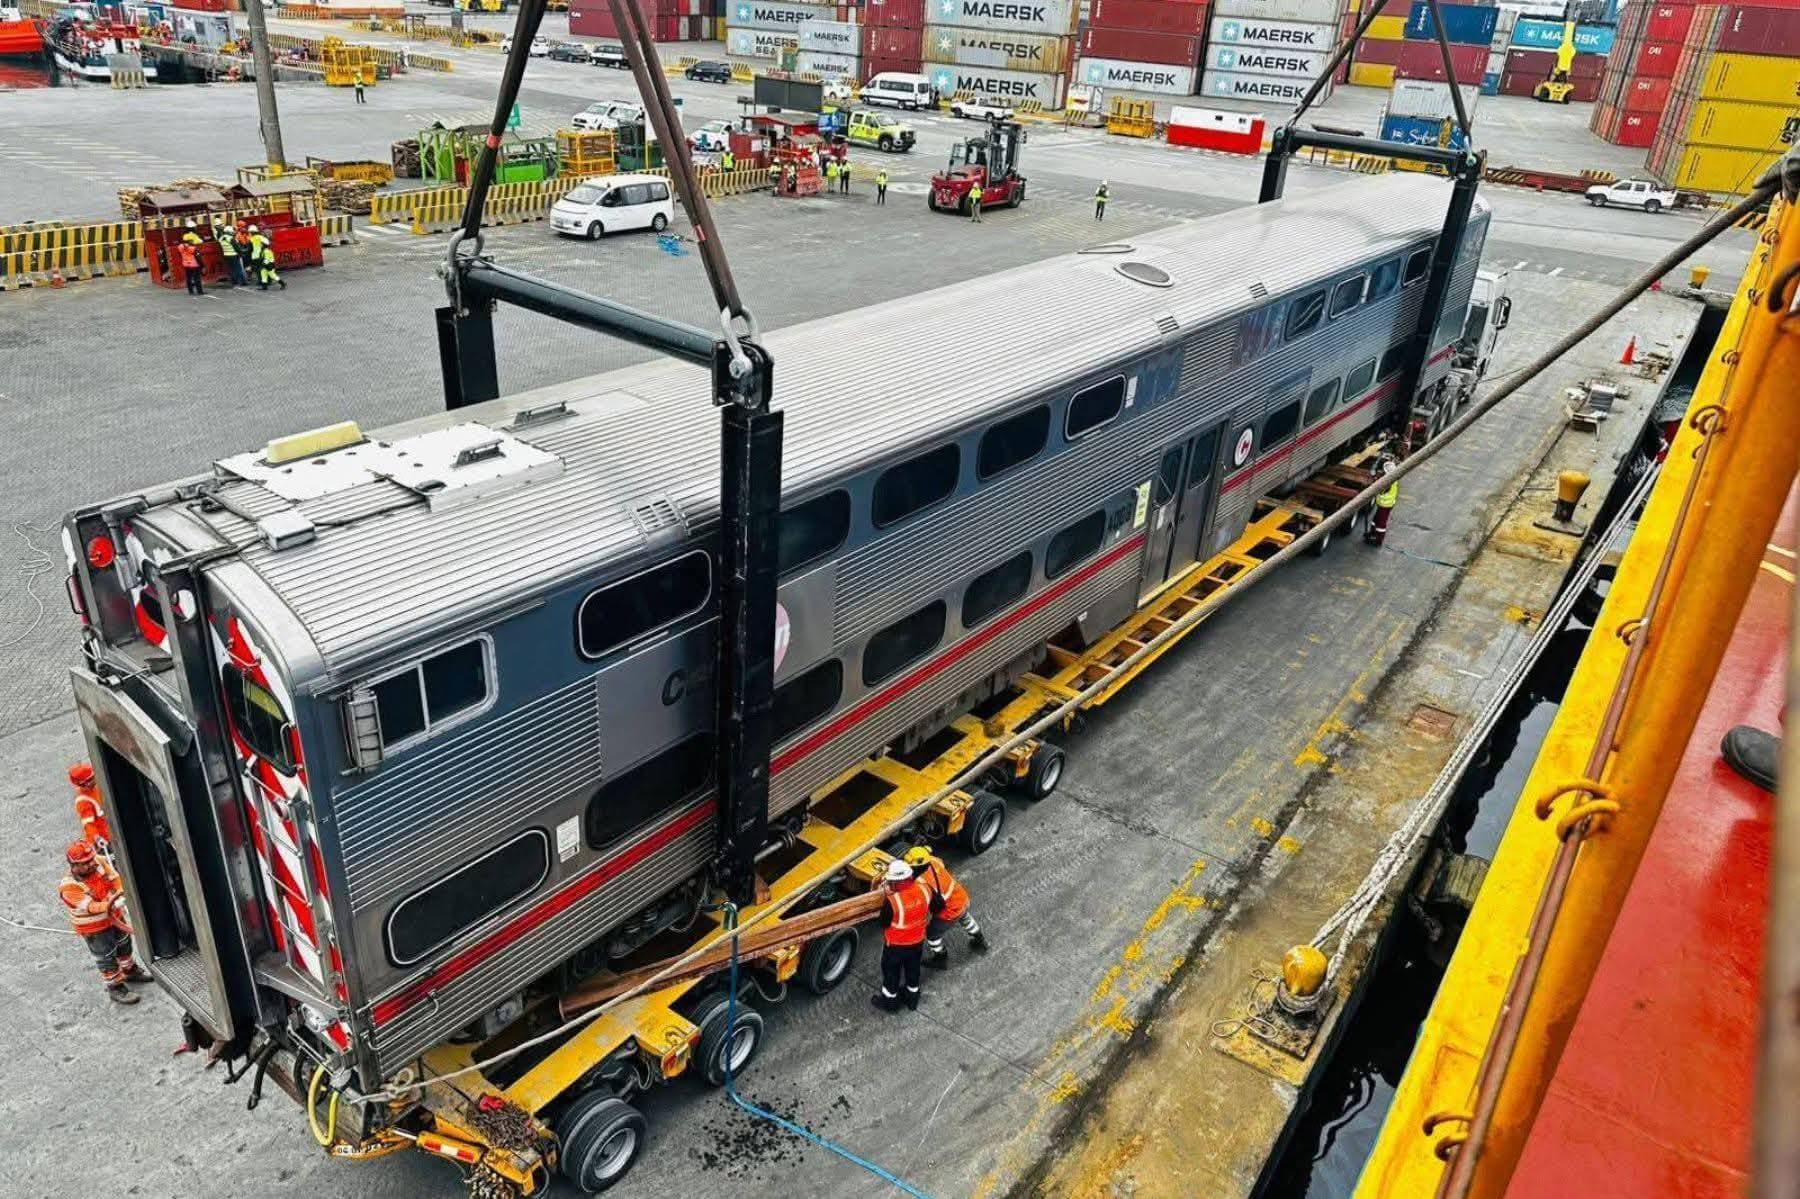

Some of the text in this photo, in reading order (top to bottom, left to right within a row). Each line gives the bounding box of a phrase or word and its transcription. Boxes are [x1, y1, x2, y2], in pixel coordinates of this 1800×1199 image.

[962, 1, 1045, 22] MAERSK
[755, 35, 798, 48] MAERS
[814, 31, 850, 42] MAERSK
[1243, 27, 1315, 45] MAERSK
[1540, 29, 1600, 45] MARSK
[812, 62, 849, 73] MAERSK
[1238, 54, 1311, 72] MAERSK
[1107, 67, 1177, 86] MAERSK
[956, 75, 1037, 98] MAERSK
[1233, 81, 1305, 100] MAERSK
